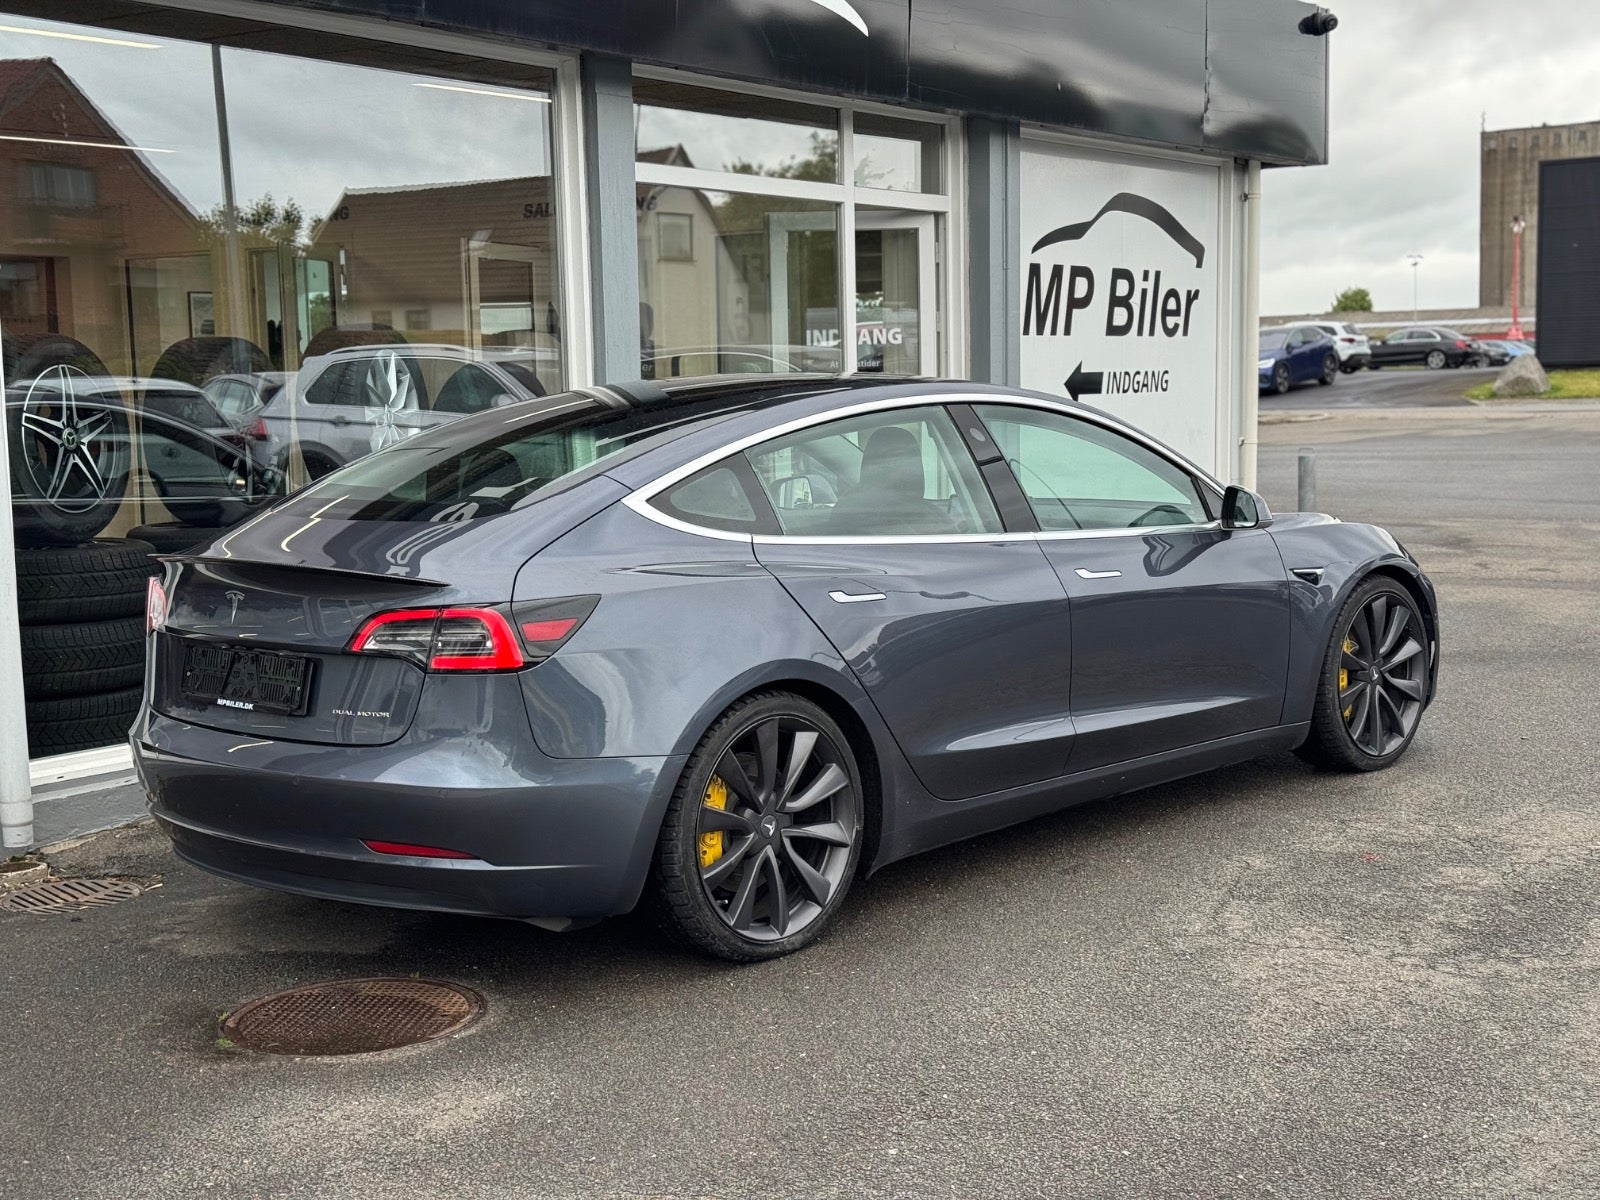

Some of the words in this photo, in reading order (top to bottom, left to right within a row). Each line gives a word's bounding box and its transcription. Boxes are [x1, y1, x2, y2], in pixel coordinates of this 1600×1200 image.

[1022, 262, 1095, 336] MP
[1105, 267, 1200, 338] Biler
[806, 328, 902, 346] INDANG
[1106, 370, 1169, 395] INDGANG
[217, 698, 254, 710] MPBILER.DK
[332, 708, 355, 717] DUAL
